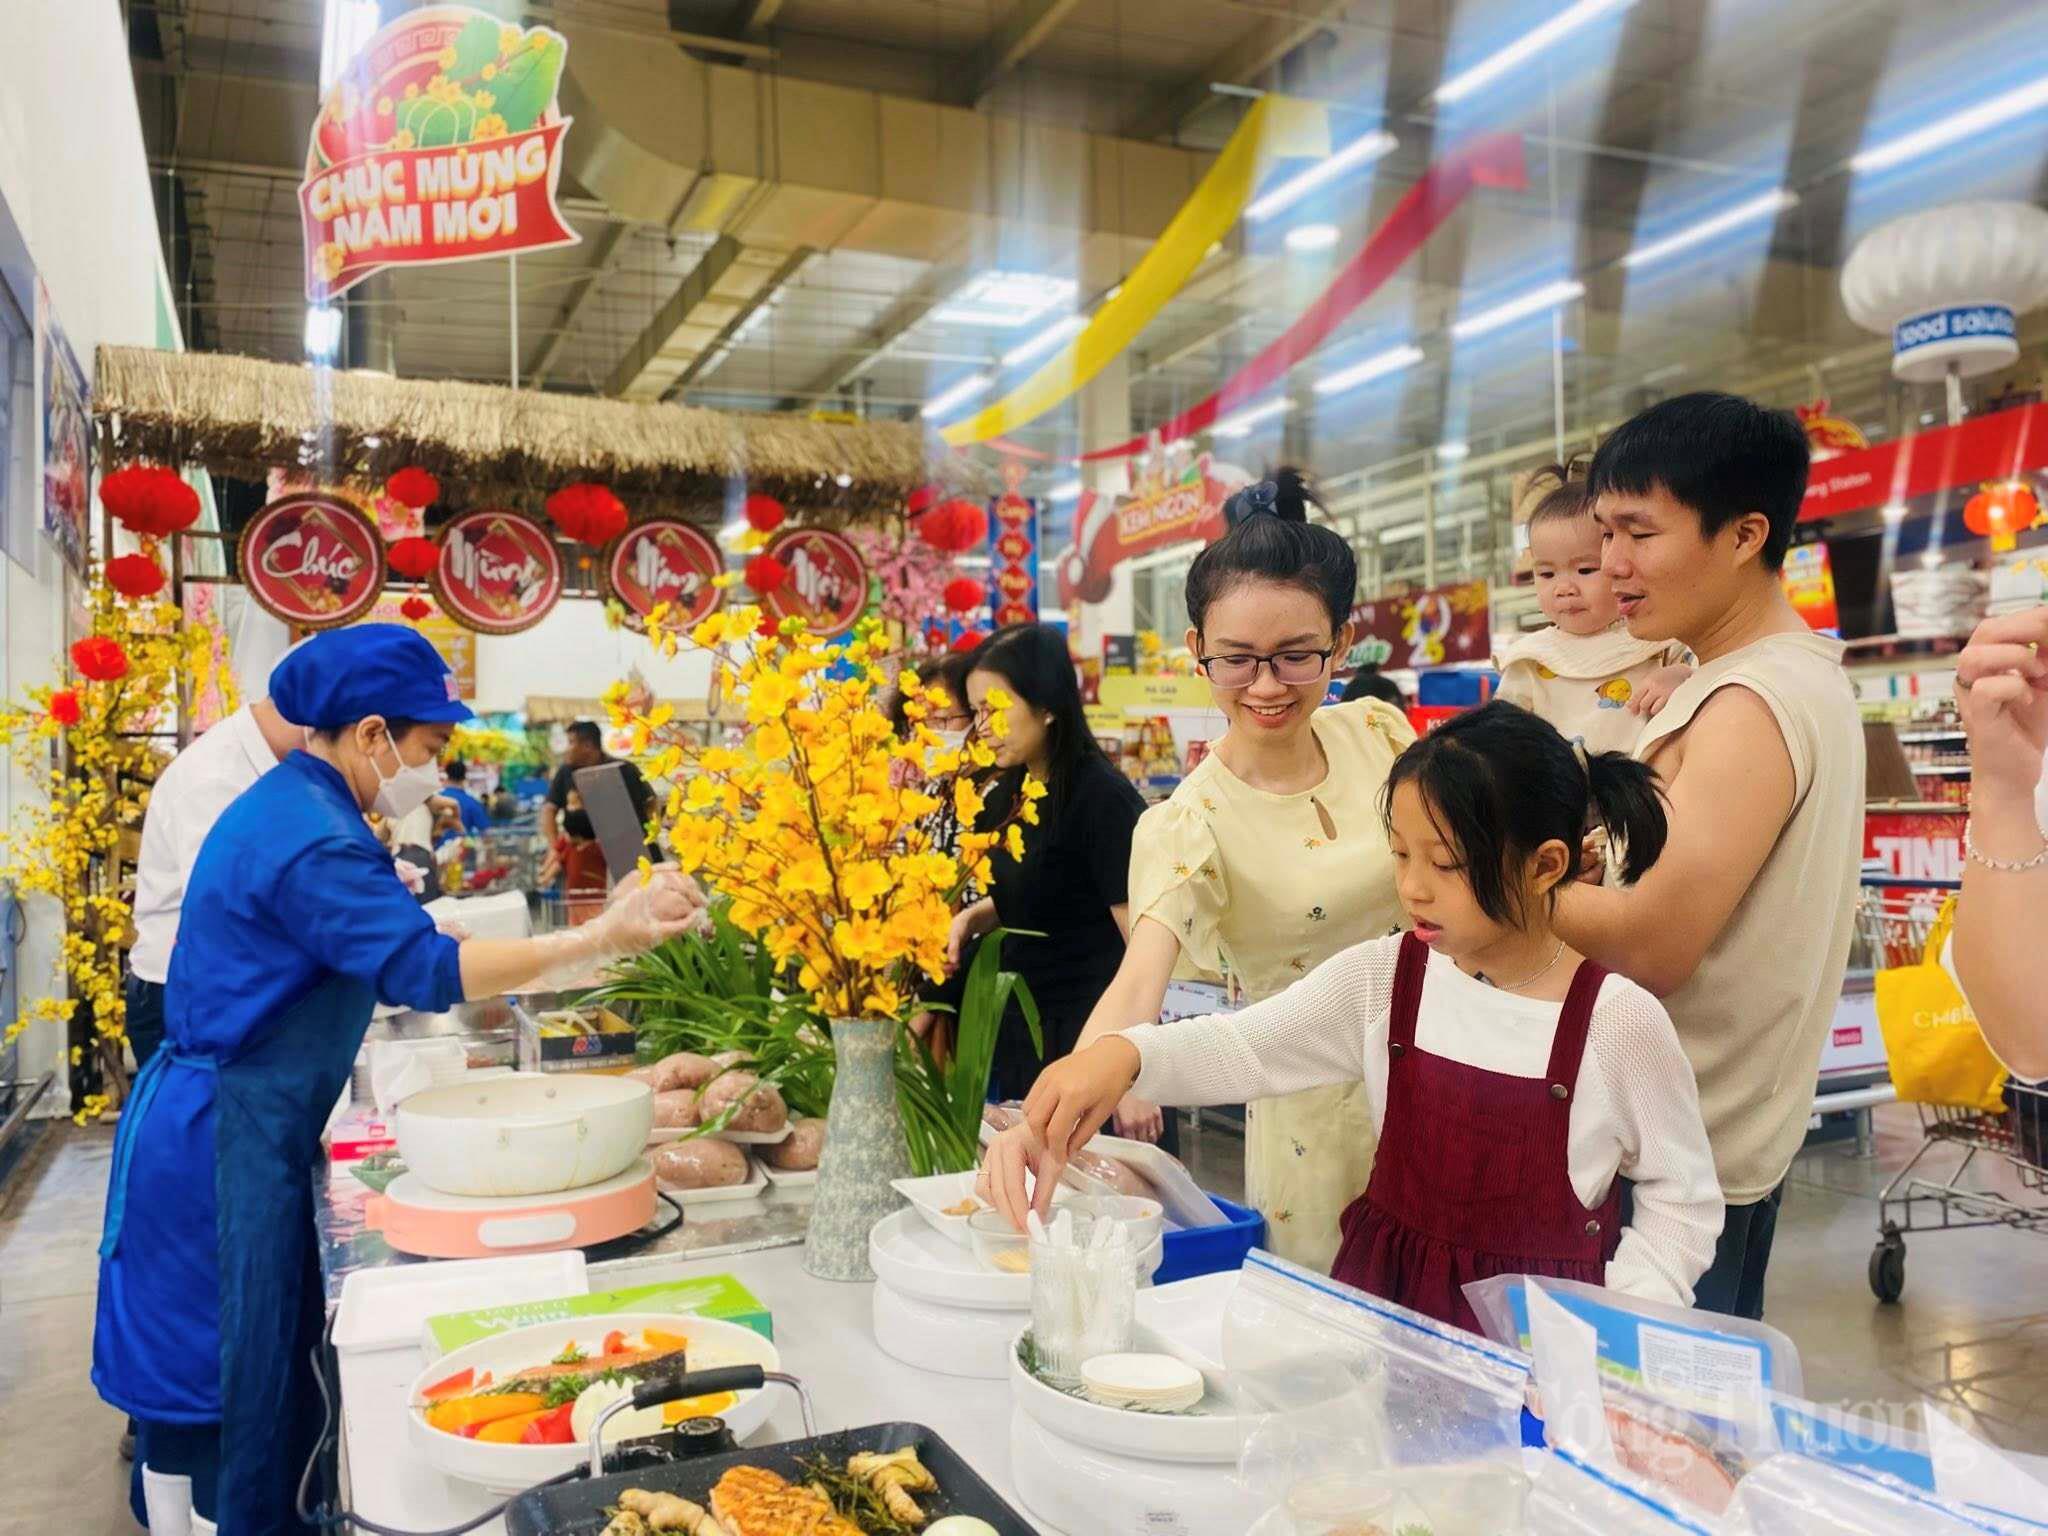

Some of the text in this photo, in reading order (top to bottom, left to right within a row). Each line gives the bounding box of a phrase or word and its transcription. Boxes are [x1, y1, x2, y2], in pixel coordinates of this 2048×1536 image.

[309, 135, 548, 222] CHÚC MỪNG
[332, 190, 519, 251] NĂM MỚI
